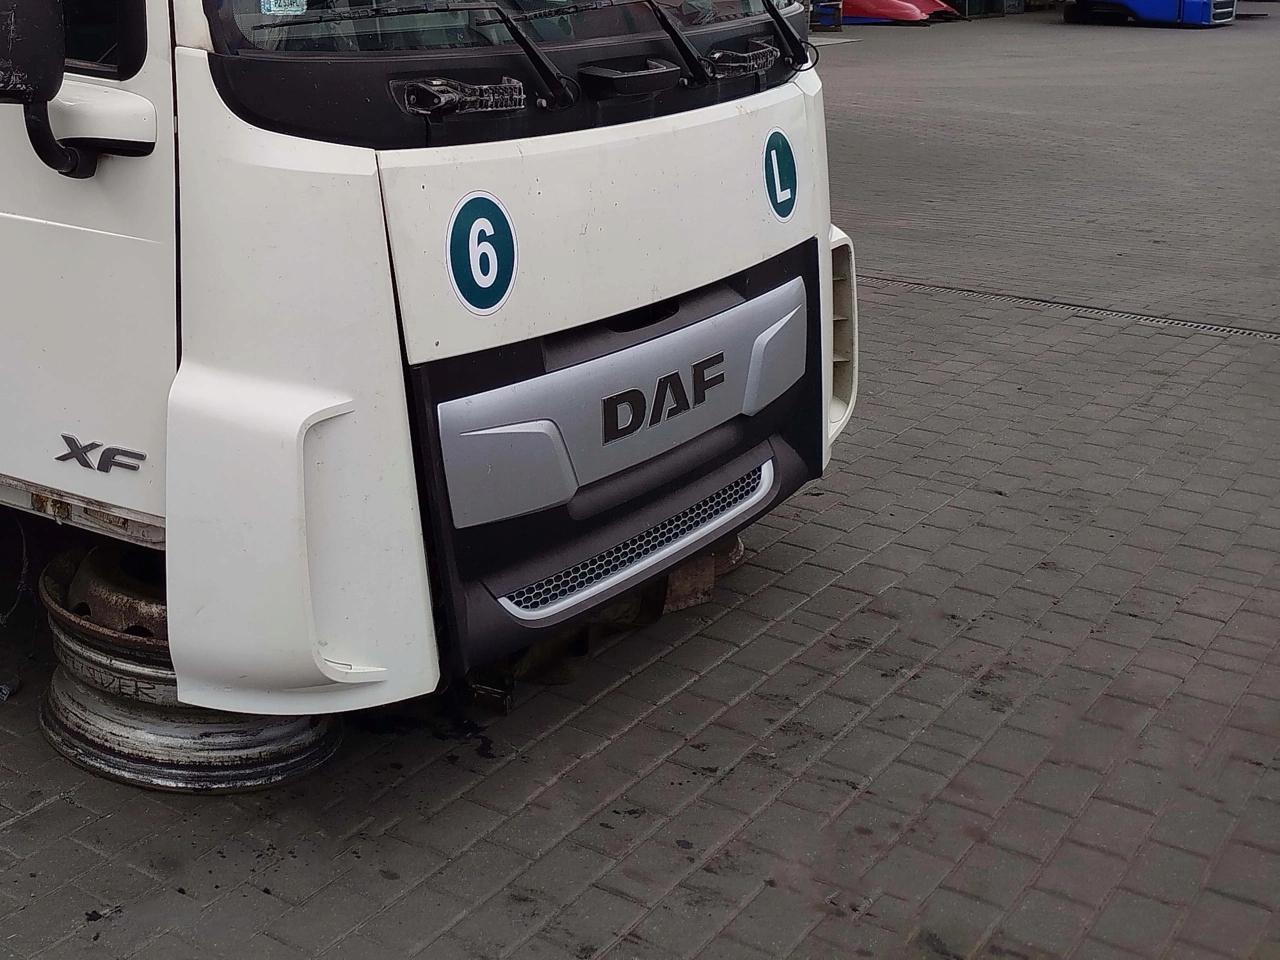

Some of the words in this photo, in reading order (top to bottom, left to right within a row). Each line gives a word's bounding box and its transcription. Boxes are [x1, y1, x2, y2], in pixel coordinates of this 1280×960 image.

[769, 149, 792, 204] L
[467, 217, 499, 289] 6
[600, 350, 727, 447] DAF
[54, 433, 148, 474] XF
